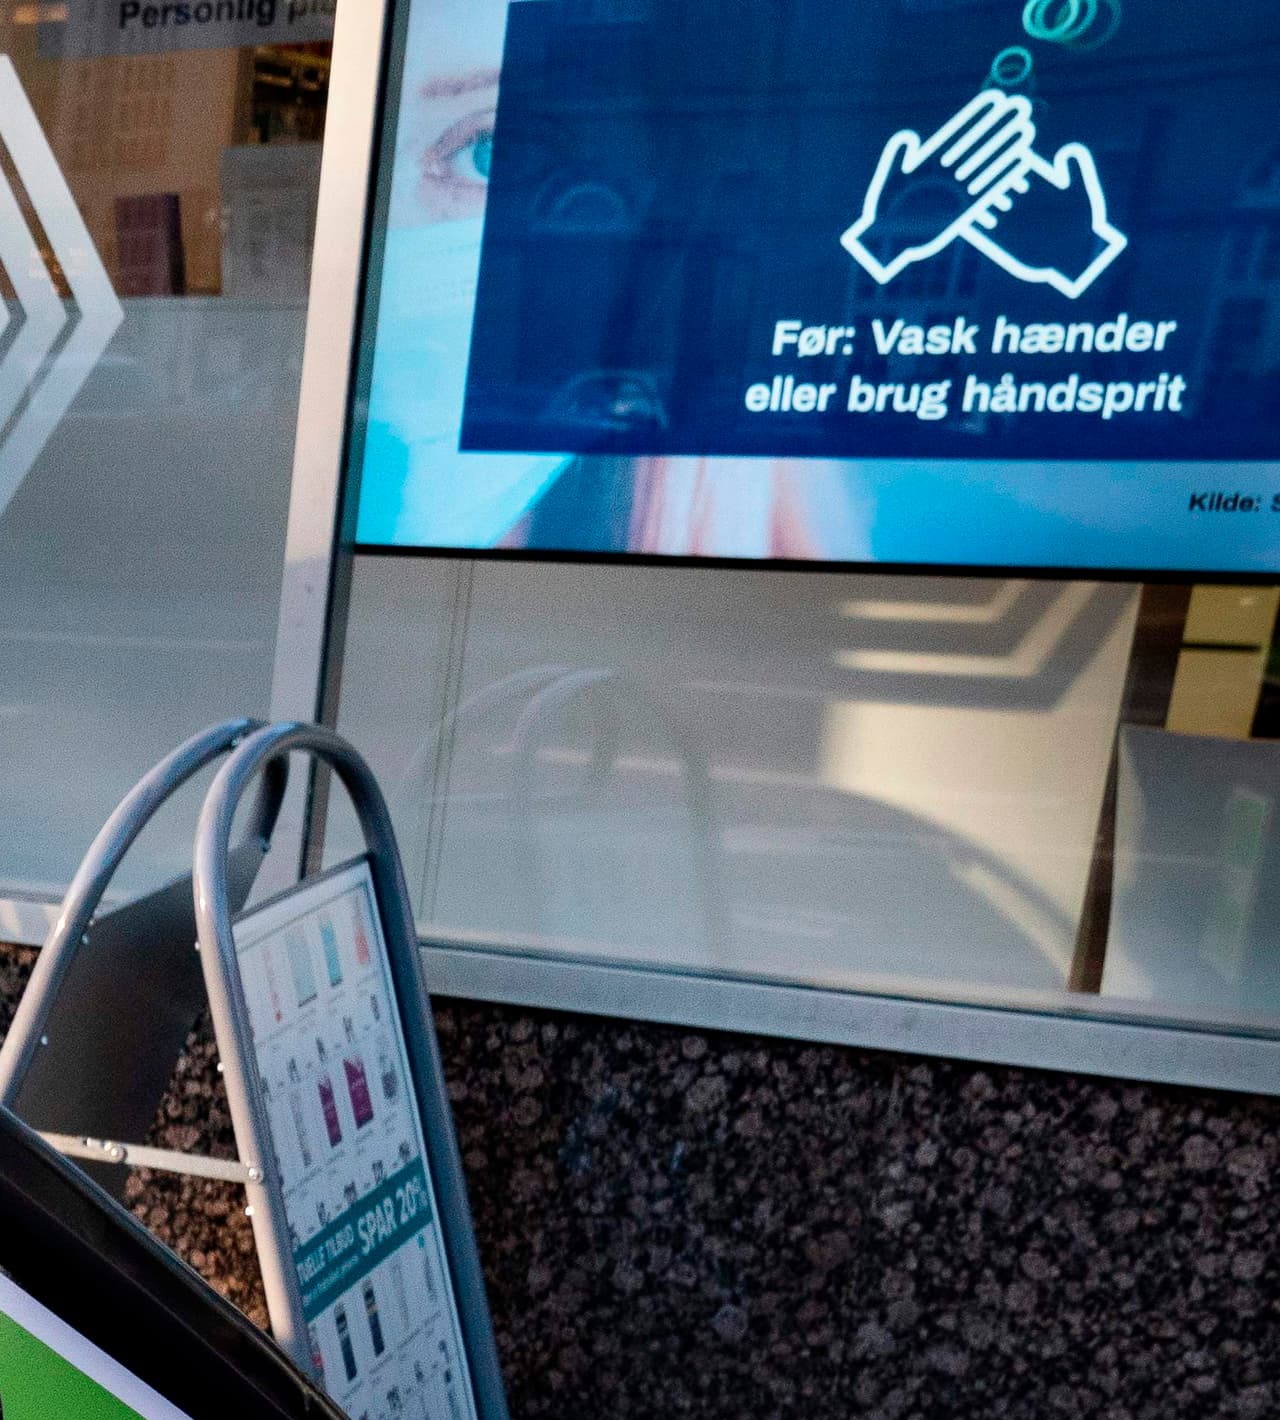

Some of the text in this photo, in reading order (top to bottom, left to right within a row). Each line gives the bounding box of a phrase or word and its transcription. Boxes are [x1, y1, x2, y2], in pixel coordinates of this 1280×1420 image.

[772, 314, 1177, 357] Før: Vask hænder
[745, 372, 1186, 420] eller brug håndsprit
[1189, 492, 1262, 514] Kilde:
[358, 1197, 397, 1256] SPAR
